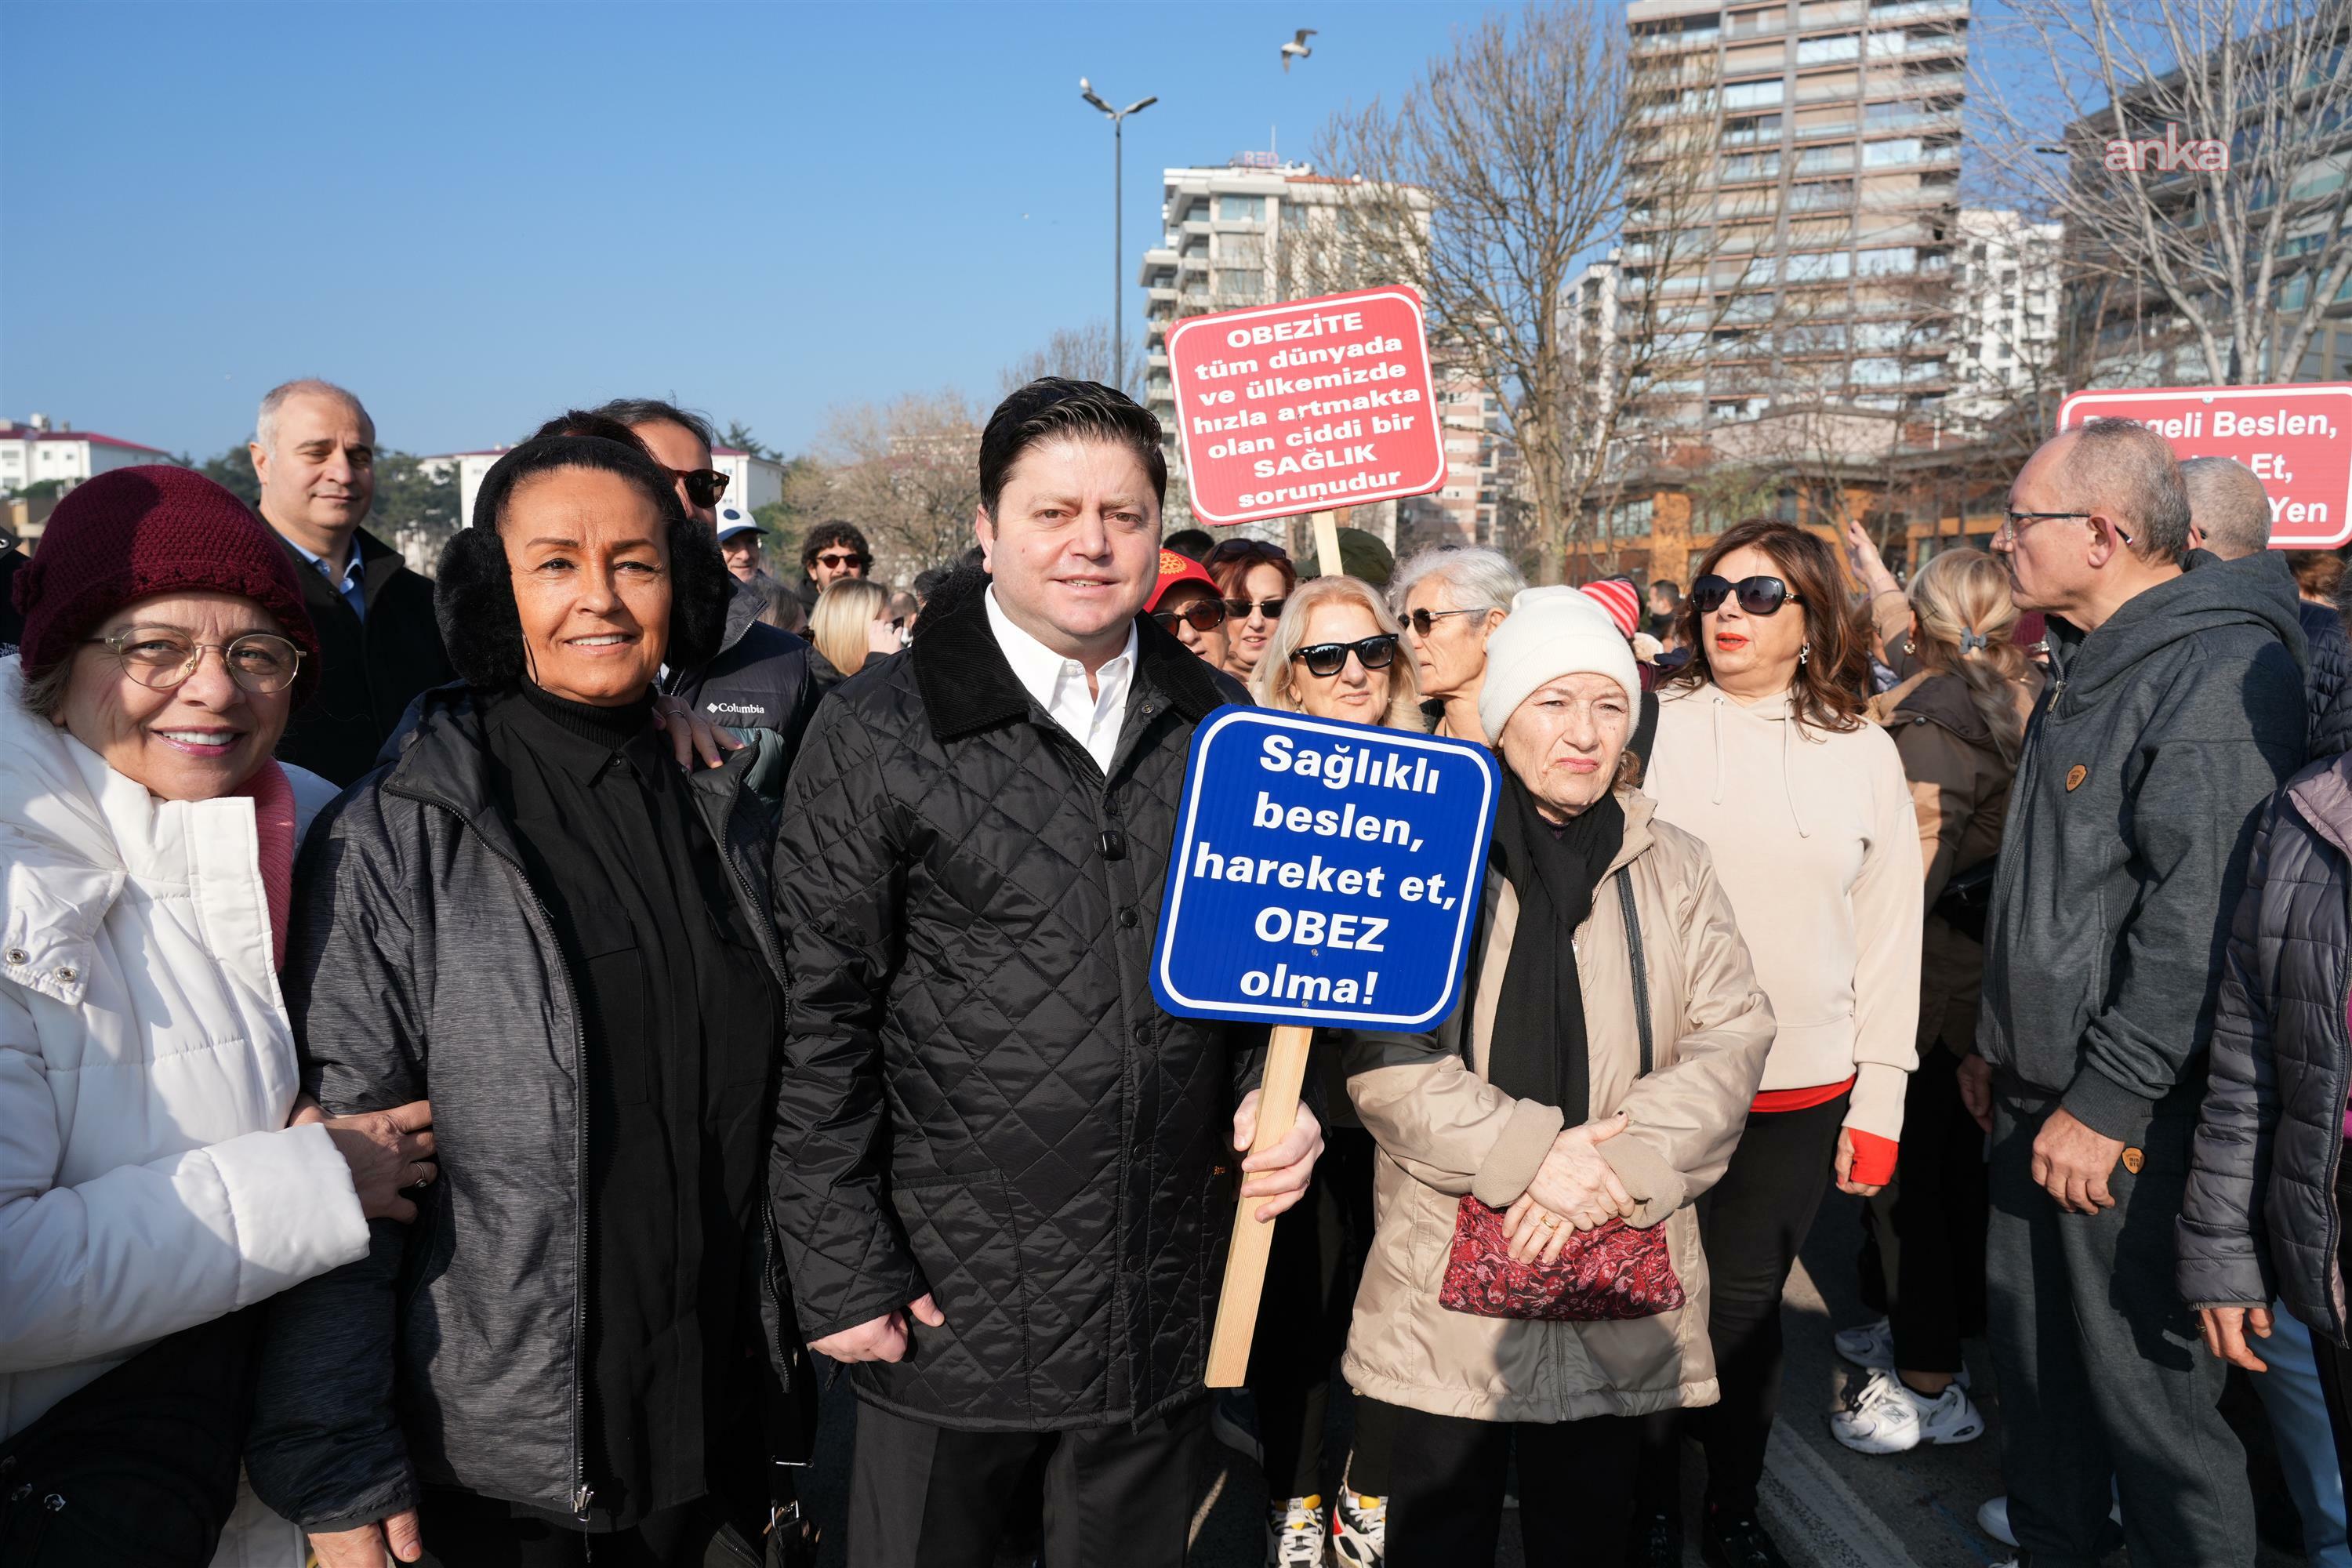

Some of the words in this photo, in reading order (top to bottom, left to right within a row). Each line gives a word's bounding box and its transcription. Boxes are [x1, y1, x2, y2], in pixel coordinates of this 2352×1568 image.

[1227, 312, 1363, 348] OBEZİTE
[1194, 358, 1259, 380] tüm
[1269, 336, 1403, 369] dünyada
[1198, 390, 1236, 406] ve
[1246, 361, 1406, 400] ülkemizde
[1192, 409, 1268, 435] hızla
[1277, 388, 1421, 422] artmakta
[2212, 409, 2337, 440] Beslen,
[1207, 437, 1276, 459] olan
[1285, 419, 1363, 447] ciddi
[1371, 413, 1415, 434] bir
[1254, 443, 1378, 478] SAĞLIK
[2250, 453, 2292, 484] Et,
[1238, 470, 1402, 508] sorunudur
[2267, 496, 2328, 523] Yen
[717, 702, 765, 714] Columbia
[1260, 735, 1439, 794] Sağlıklı
[1253, 791, 1424, 852] beslen,
[1193, 841, 1385, 898] hareket
[1399, 873, 1456, 910] et,
[1254, 906, 1389, 953] OBEZ
[1240, 963, 1378, 1005] olma!
